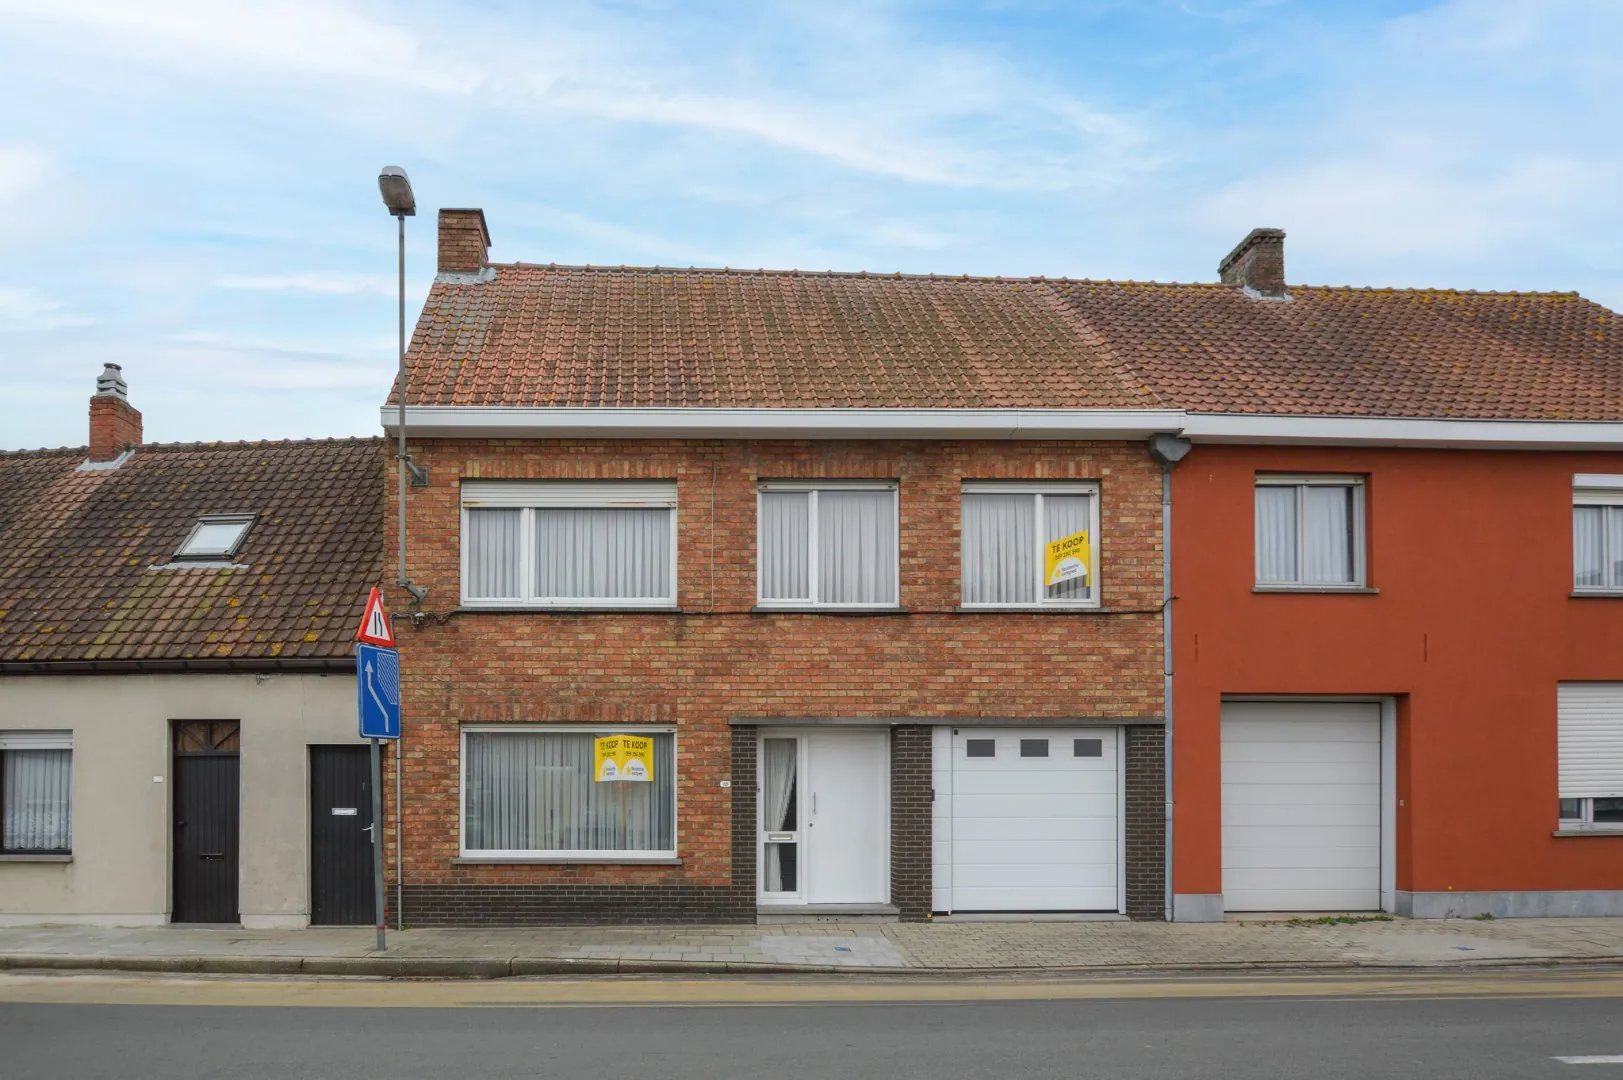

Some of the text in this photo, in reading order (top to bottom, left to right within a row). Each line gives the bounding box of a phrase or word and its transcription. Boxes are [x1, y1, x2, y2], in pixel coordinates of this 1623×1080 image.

[1052, 536, 1084, 553] TE KOOP
[600, 740, 618, 750] TE KOOP
[623, 740, 647, 749] TE KOOP
